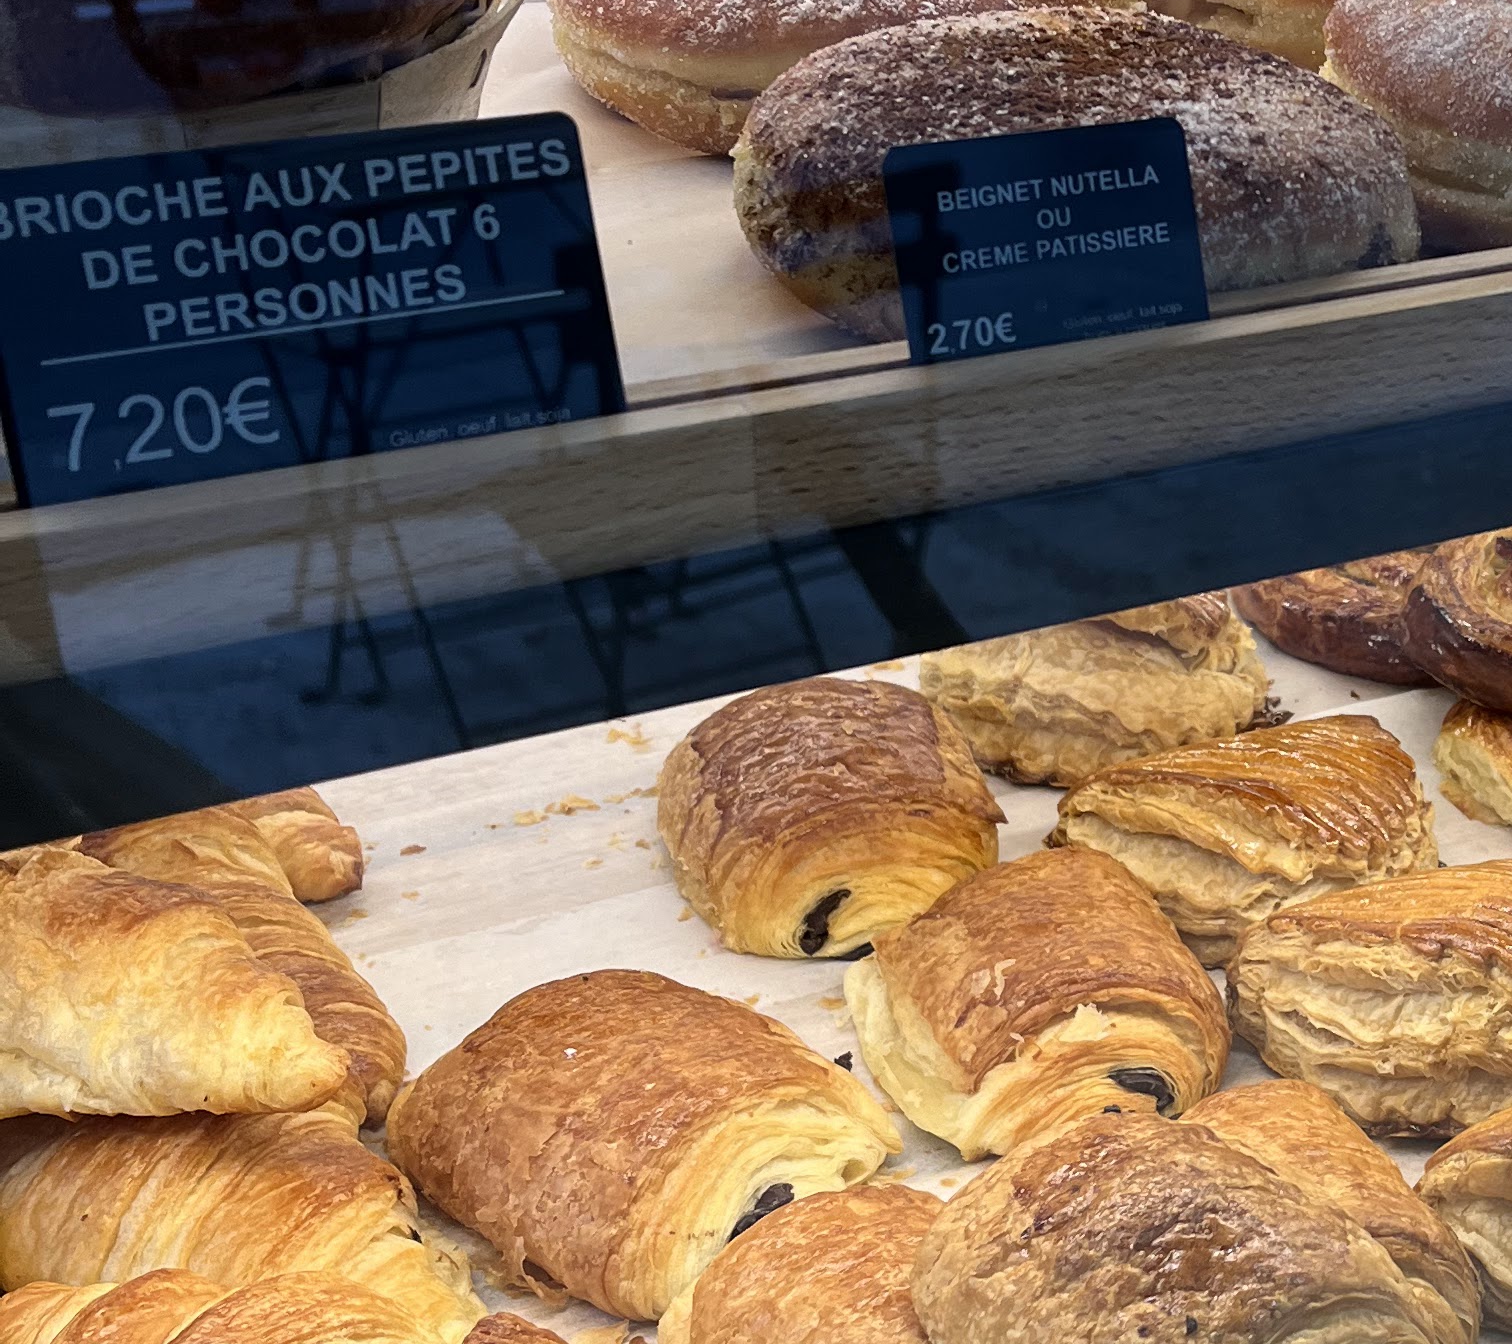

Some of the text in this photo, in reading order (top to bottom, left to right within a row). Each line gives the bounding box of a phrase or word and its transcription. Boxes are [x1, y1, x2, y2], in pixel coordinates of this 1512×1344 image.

[243, 162, 351, 212] AUX
[364, 139, 571, 197] PEPITES
[937, 165, 1160, 212] BEIGNET NUTELLA
[81, 203, 500, 290] DE CHOCOLAT 6
[942, 222, 1170, 274] CREME PATISSIERE
[1037, 207, 1071, 229] OU
[144, 264, 467, 342] PERSONNES
[927, 312, 1017, 355] 2,70€
[46, 376, 280, 473] 7,20€
